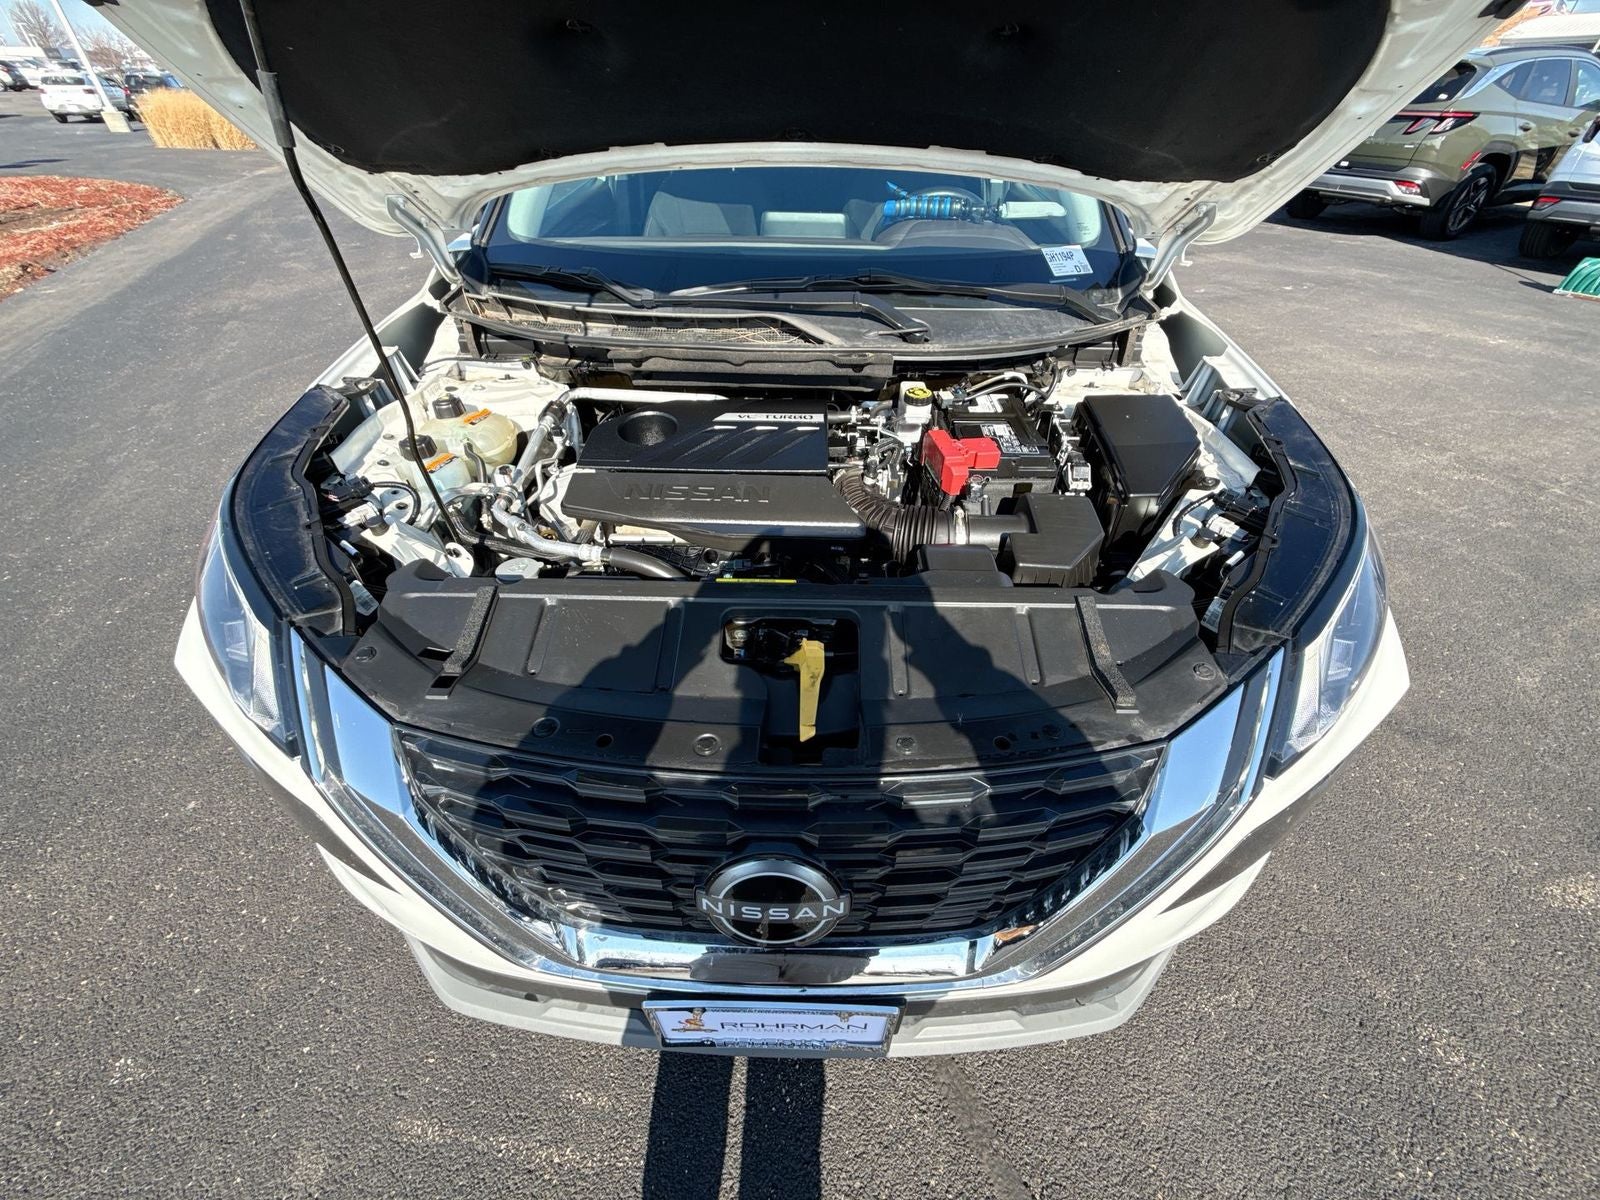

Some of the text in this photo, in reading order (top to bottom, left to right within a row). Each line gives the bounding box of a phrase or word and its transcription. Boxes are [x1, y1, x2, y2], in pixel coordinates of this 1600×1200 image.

[624, 483, 770, 503] NISSAN
[701, 897, 845, 921] NISSAN
[720, 1021, 868, 1030] ROHRMAN
